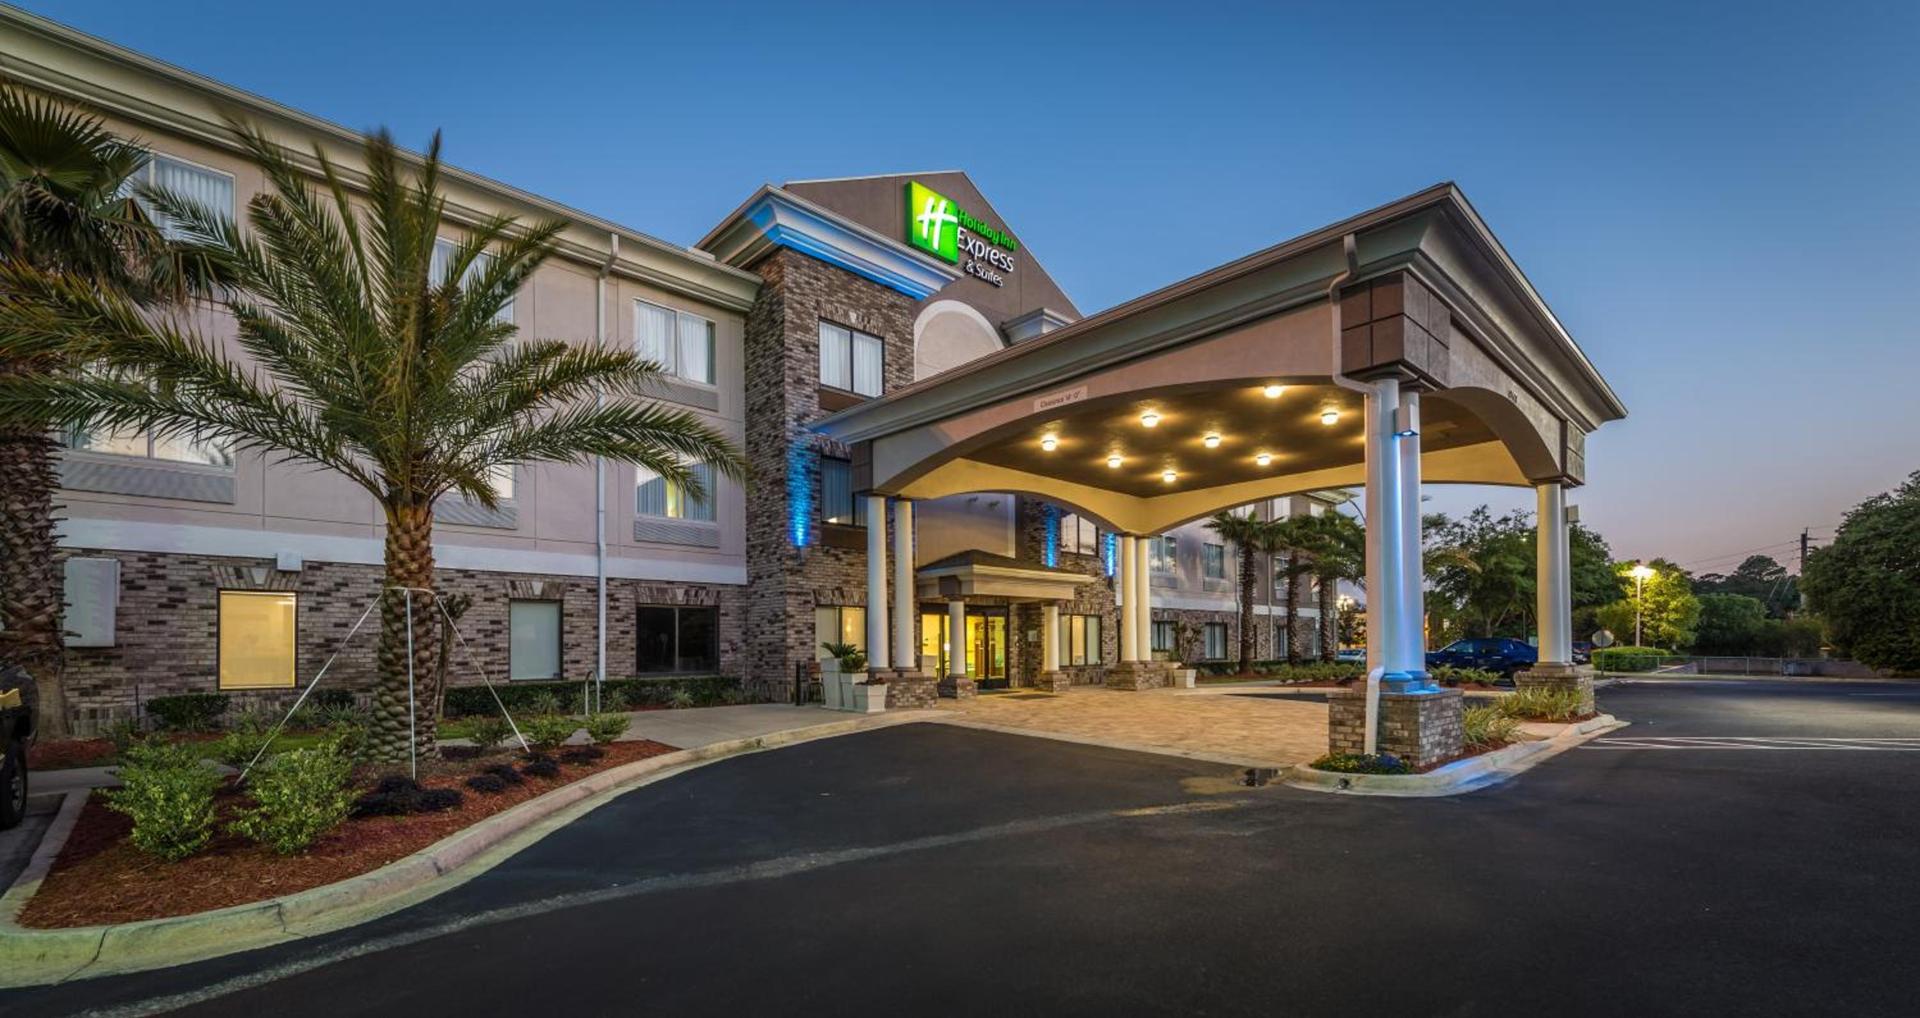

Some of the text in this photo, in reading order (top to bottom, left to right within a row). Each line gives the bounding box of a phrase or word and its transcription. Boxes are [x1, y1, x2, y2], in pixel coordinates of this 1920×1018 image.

[957, 226, 1015, 272] Express
[958, 209, 1017, 250] Holiday Inn
[966, 259, 1004, 287] & Suites
